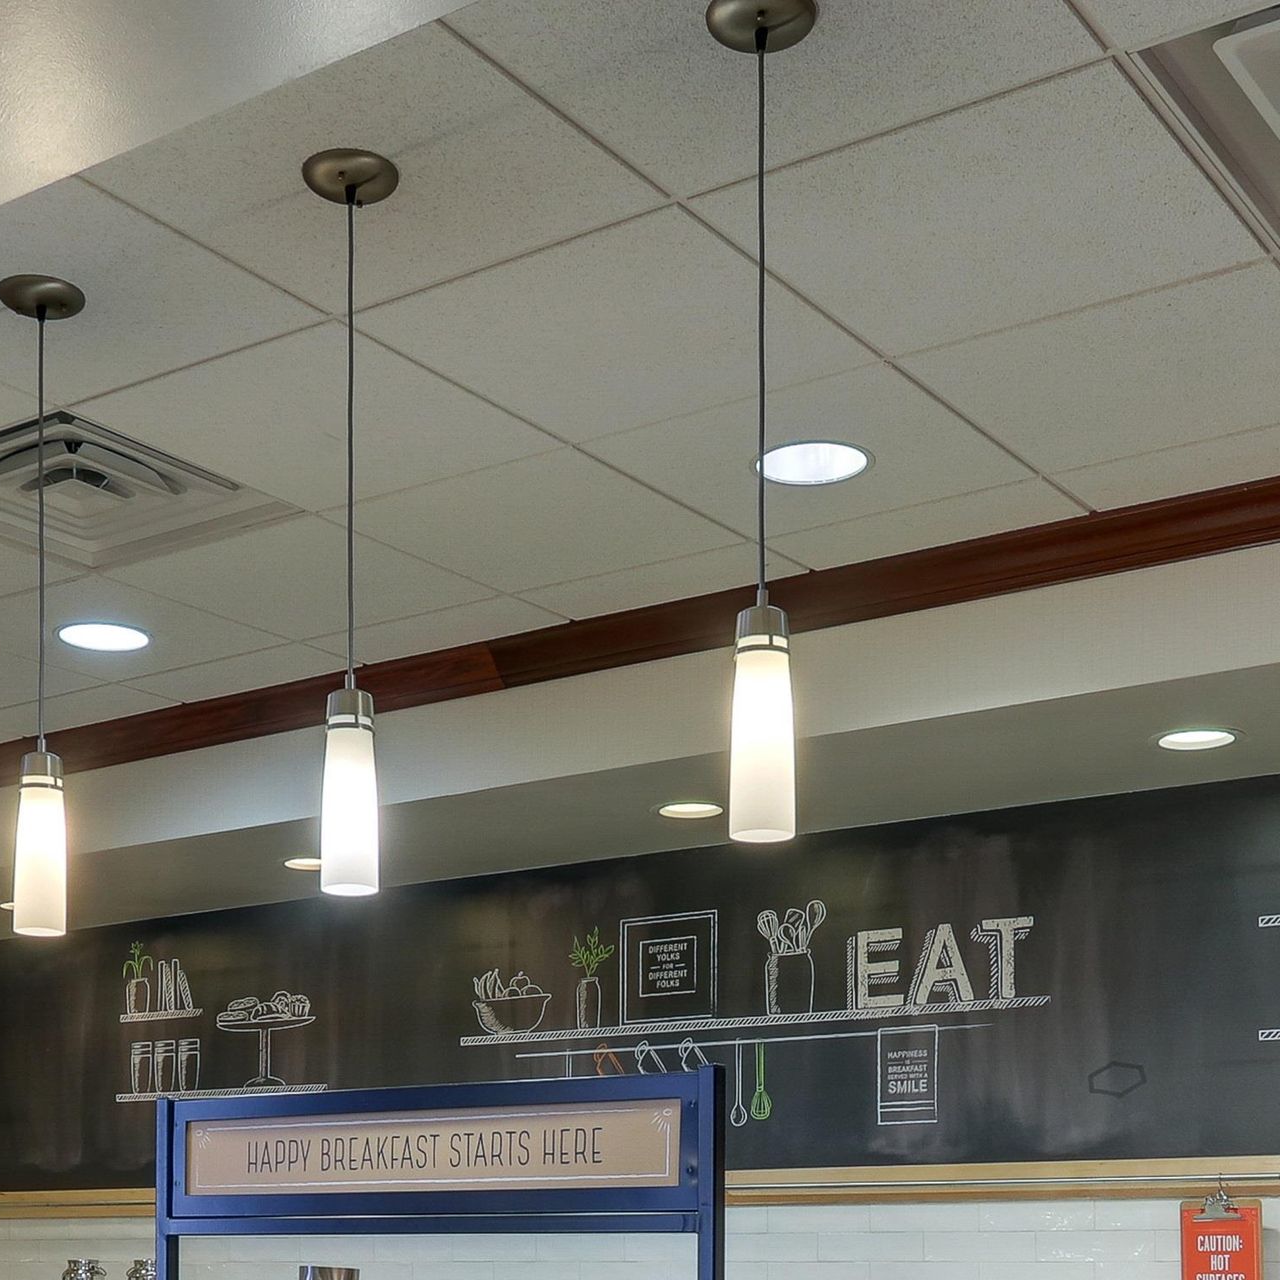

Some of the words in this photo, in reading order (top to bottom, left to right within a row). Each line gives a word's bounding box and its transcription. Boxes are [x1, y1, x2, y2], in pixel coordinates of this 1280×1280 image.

[648, 942, 688, 954] DIFFERENT
[656, 952, 680, 962] YOLKS
[847, 915, 1034, 1009] EAT
[648, 969, 688, 980] DIFFERENT
[656, 979, 680, 989] FOLKS
[887, 1049, 928, 1059] HAPPINESS
[888, 1064, 928, 1073] BREAKFAST
[888, 1079, 928, 1094] SMILE
[247, 1139, 312, 1174] HAPPY
[320, 1134, 441, 1172] BREAKFAST
[449, 1129, 531, 1168] STARTS
[543, 1127, 604, 1165] HERE
[1197, 1235, 1243, 1252] CAUTION:
[1210, 1254, 1230, 1271] HOT
